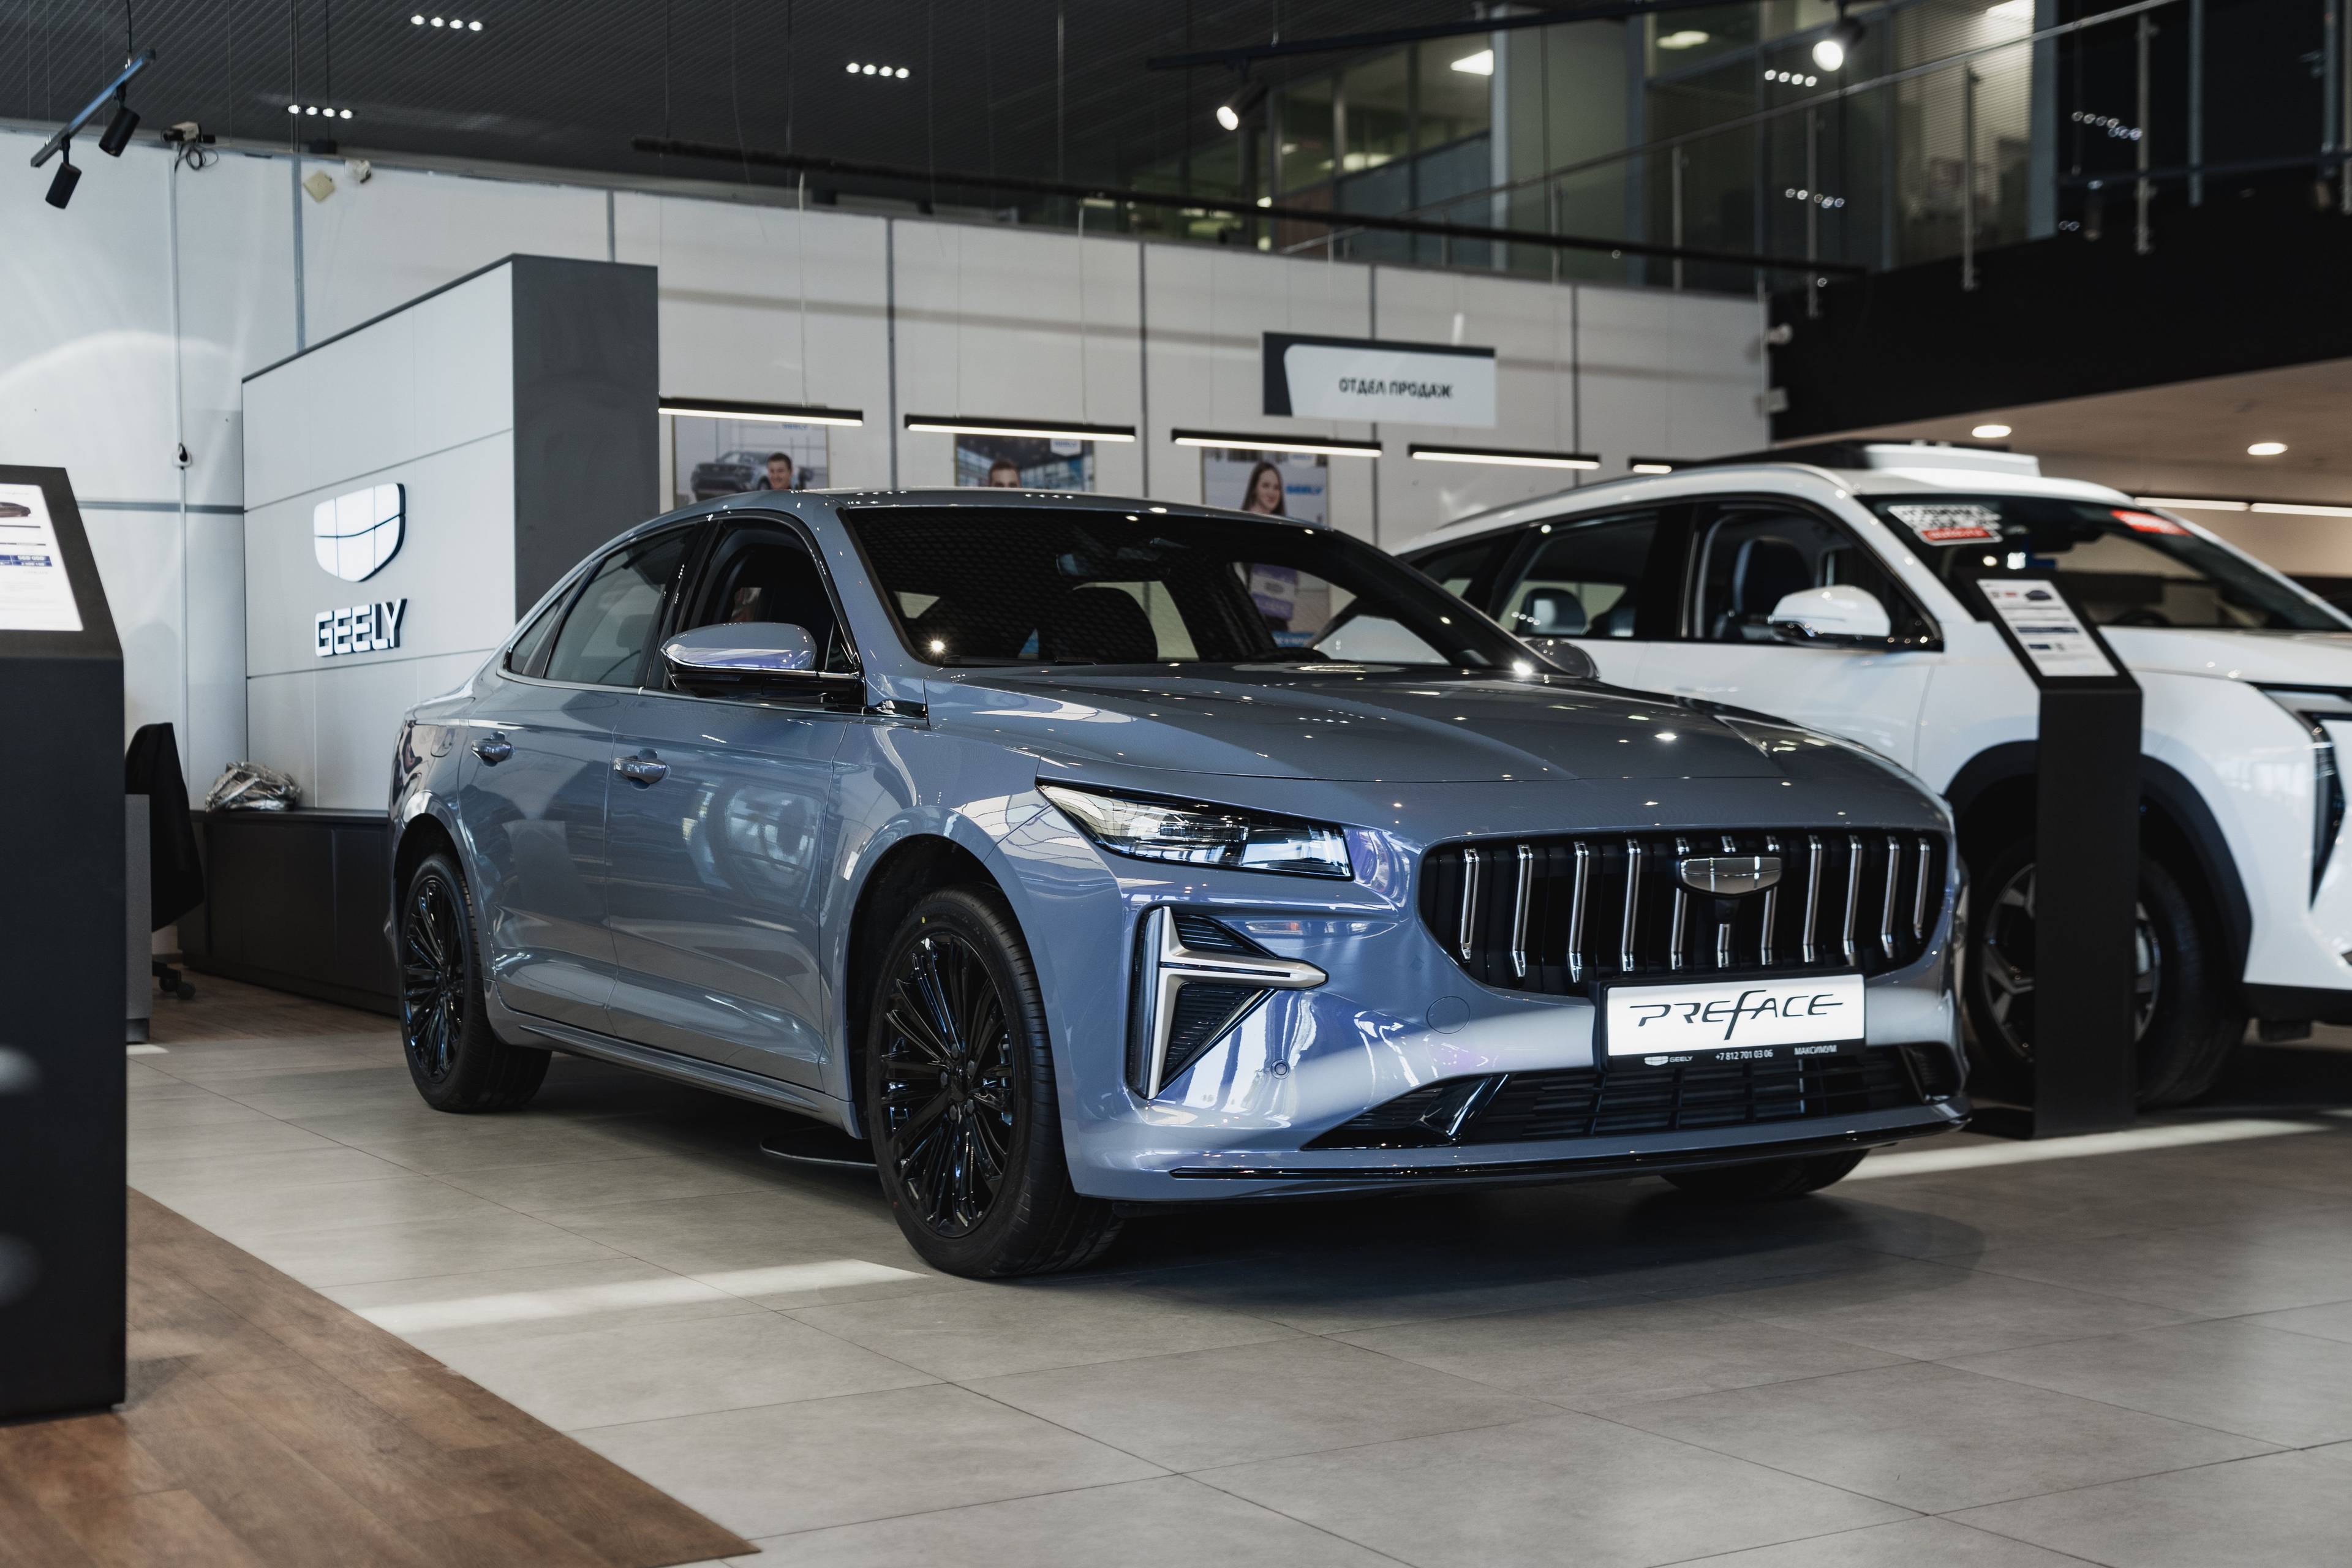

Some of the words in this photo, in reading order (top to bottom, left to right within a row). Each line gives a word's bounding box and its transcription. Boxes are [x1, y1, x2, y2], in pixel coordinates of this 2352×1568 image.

[1338, 377, 1386, 396] ОТДЕЛ
[1389, 380, 1453, 399] ПРОДАЖ
[315, 598, 407, 657] GEELY
[1716, 1052, 1724, 1061] +7
[1725, 1052, 1740, 1060] 812
[1740, 1050, 1752, 1059] 701
[1754, 1050, 1763, 1058] 03
[1764, 1049, 1774, 1058] 06
